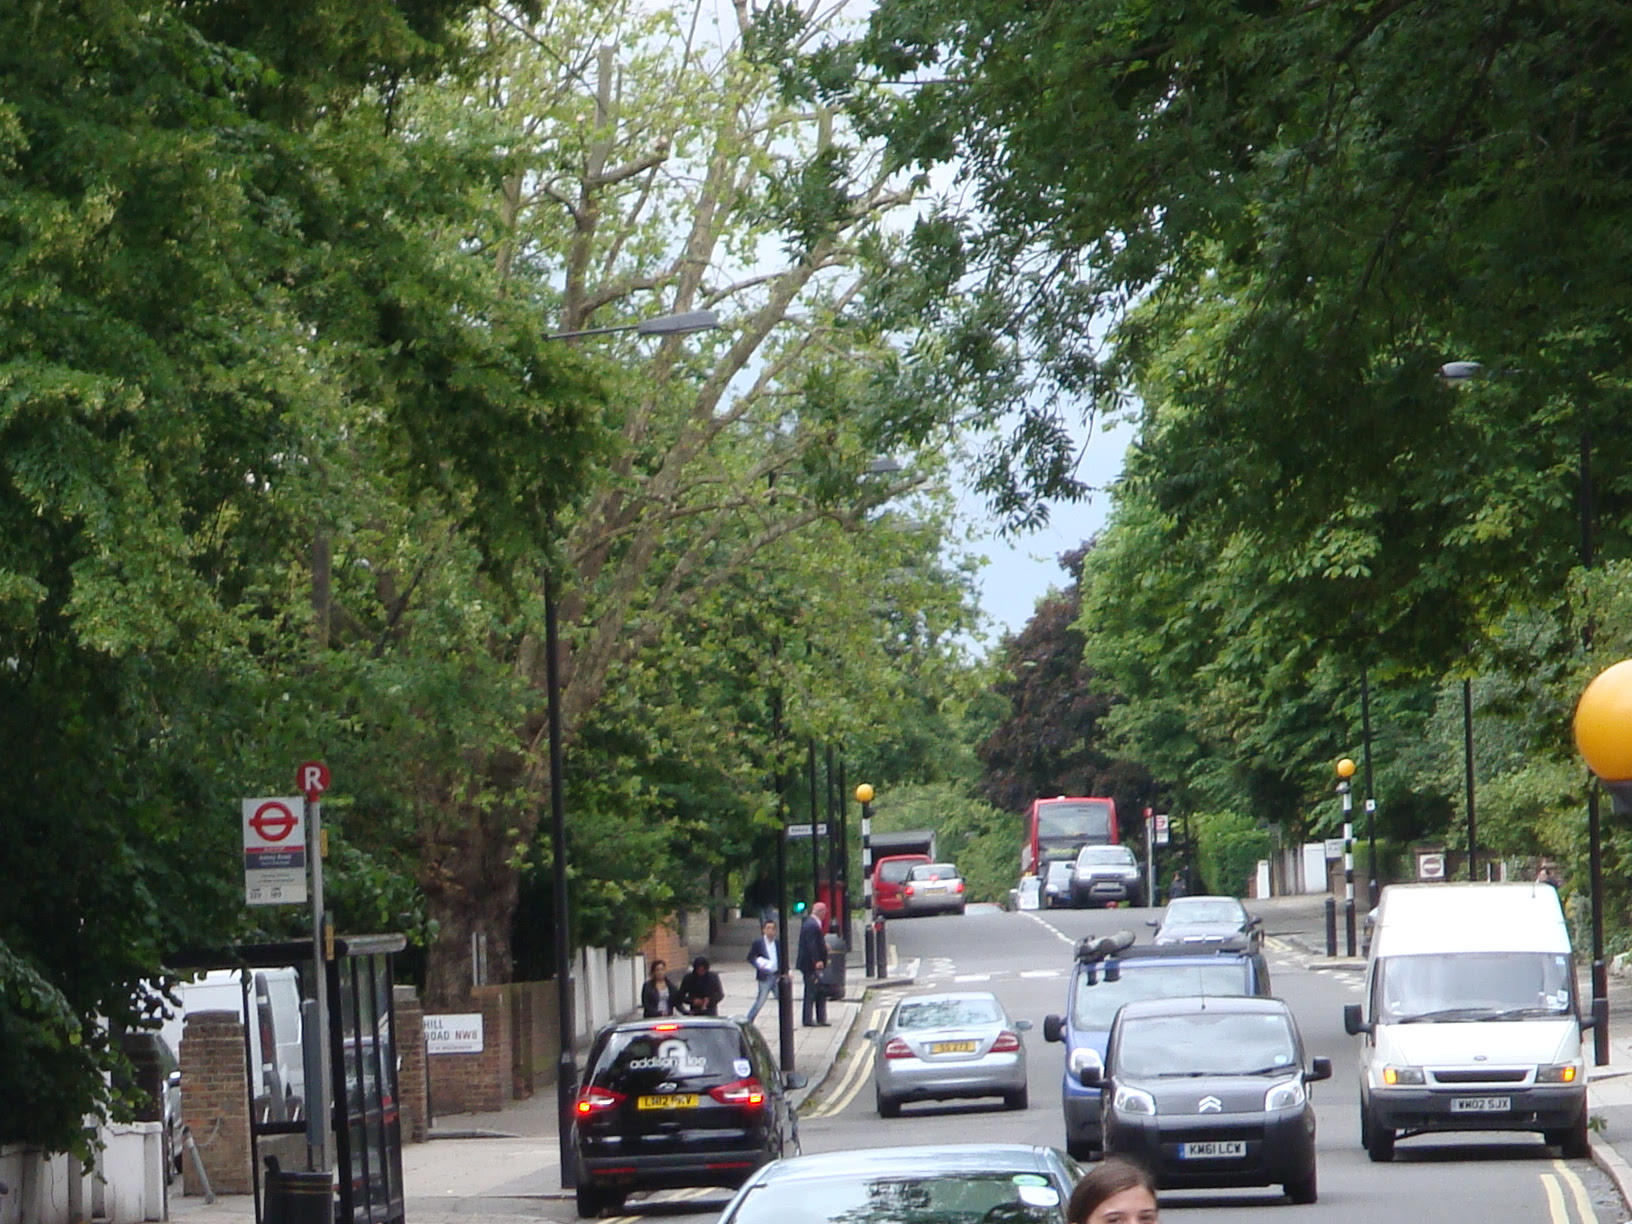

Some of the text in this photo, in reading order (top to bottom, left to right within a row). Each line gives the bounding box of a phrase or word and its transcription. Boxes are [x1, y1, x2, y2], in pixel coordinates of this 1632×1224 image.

[304, 766, 324, 791] R
[424, 1019, 443, 1030] HILL
[455, 1030, 478, 1040] NW8
